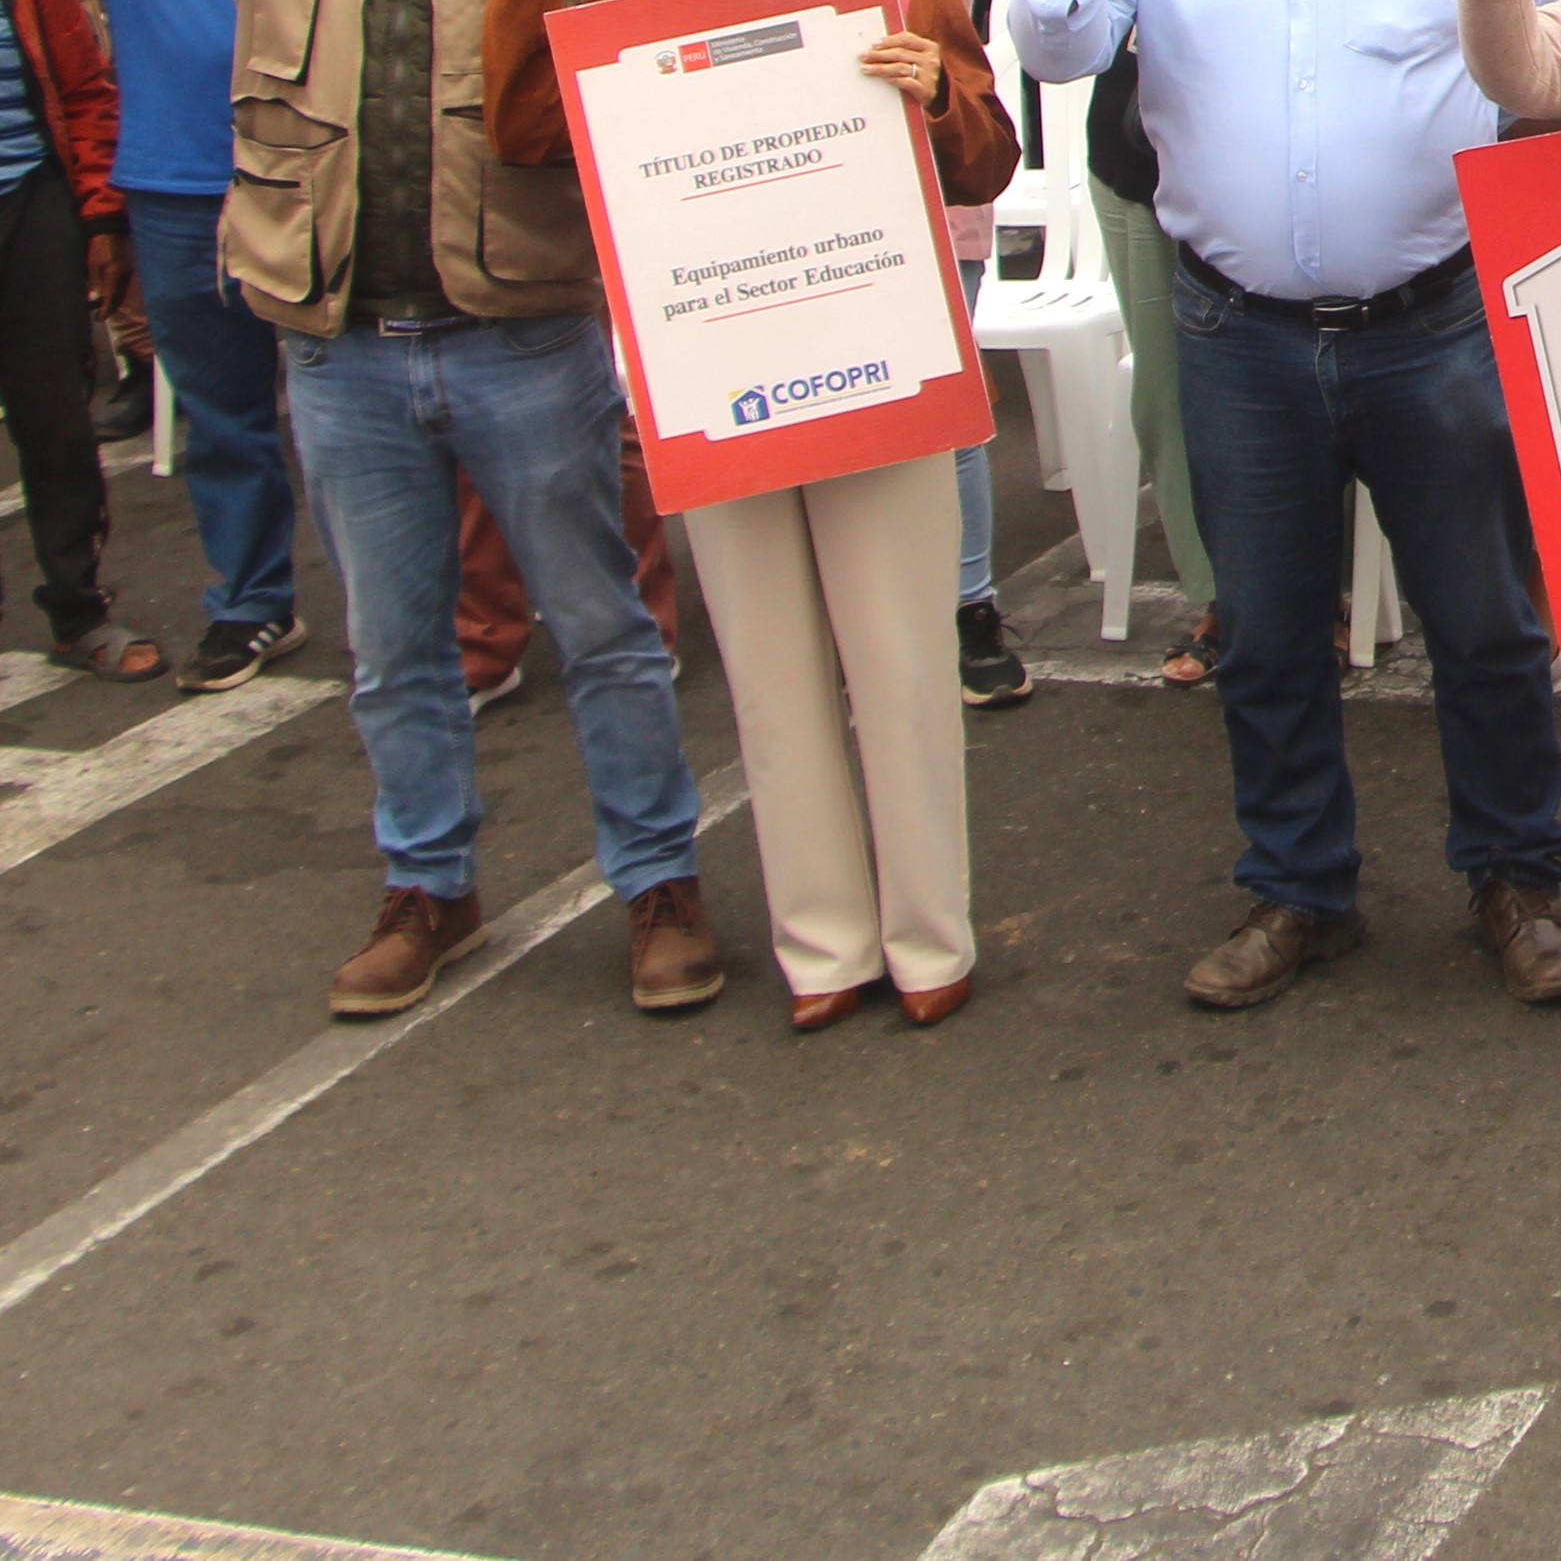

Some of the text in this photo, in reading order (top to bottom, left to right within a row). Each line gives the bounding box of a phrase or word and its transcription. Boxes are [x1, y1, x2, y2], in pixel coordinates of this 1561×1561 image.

[683, 51, 706, 63] PERÚ
[639, 115, 867, 180] TÍTULO DE PROPIEDAD
[693, 147, 824, 190] REGISTRADO
[670, 226, 884, 287] Equipamiento urbano
[662, 249, 905, 322] para el Sector Educación
[771, 359, 890, 404] COFOPRI
